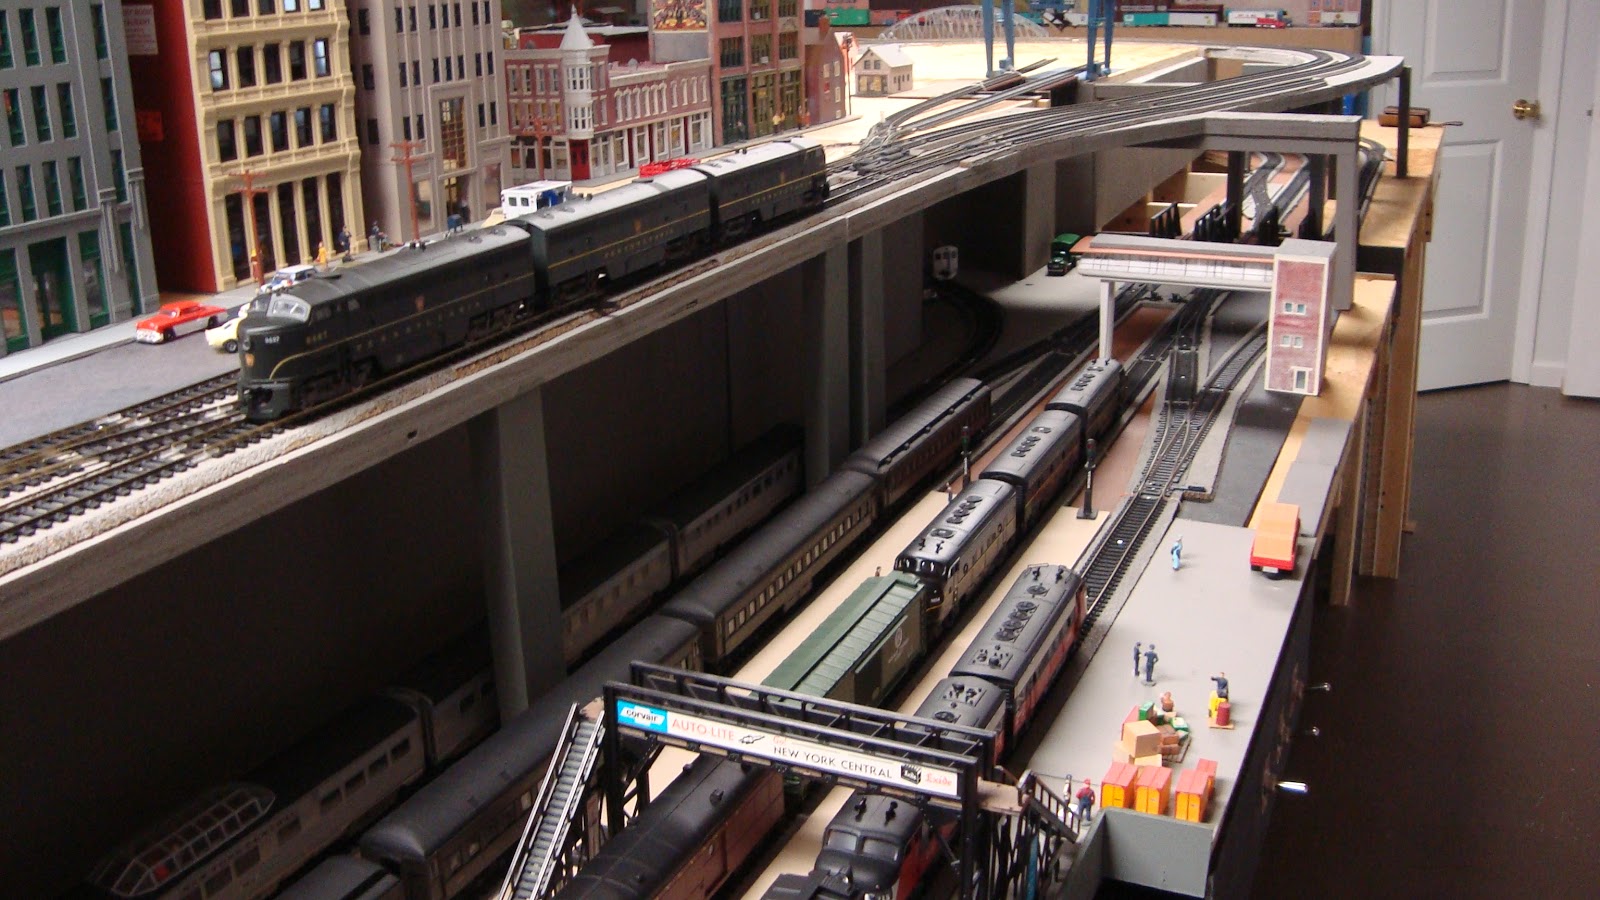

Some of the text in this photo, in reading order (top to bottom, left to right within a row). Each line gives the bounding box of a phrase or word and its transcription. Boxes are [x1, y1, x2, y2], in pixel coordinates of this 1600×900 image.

[626, 709, 658, 722] corvair
[671, 719, 735, 741] AUTO-LITE
[773, 746, 799, 758] NEW
[804, 752, 836, 766] YORK
[841, 759, 893, 779] CENTRAL
